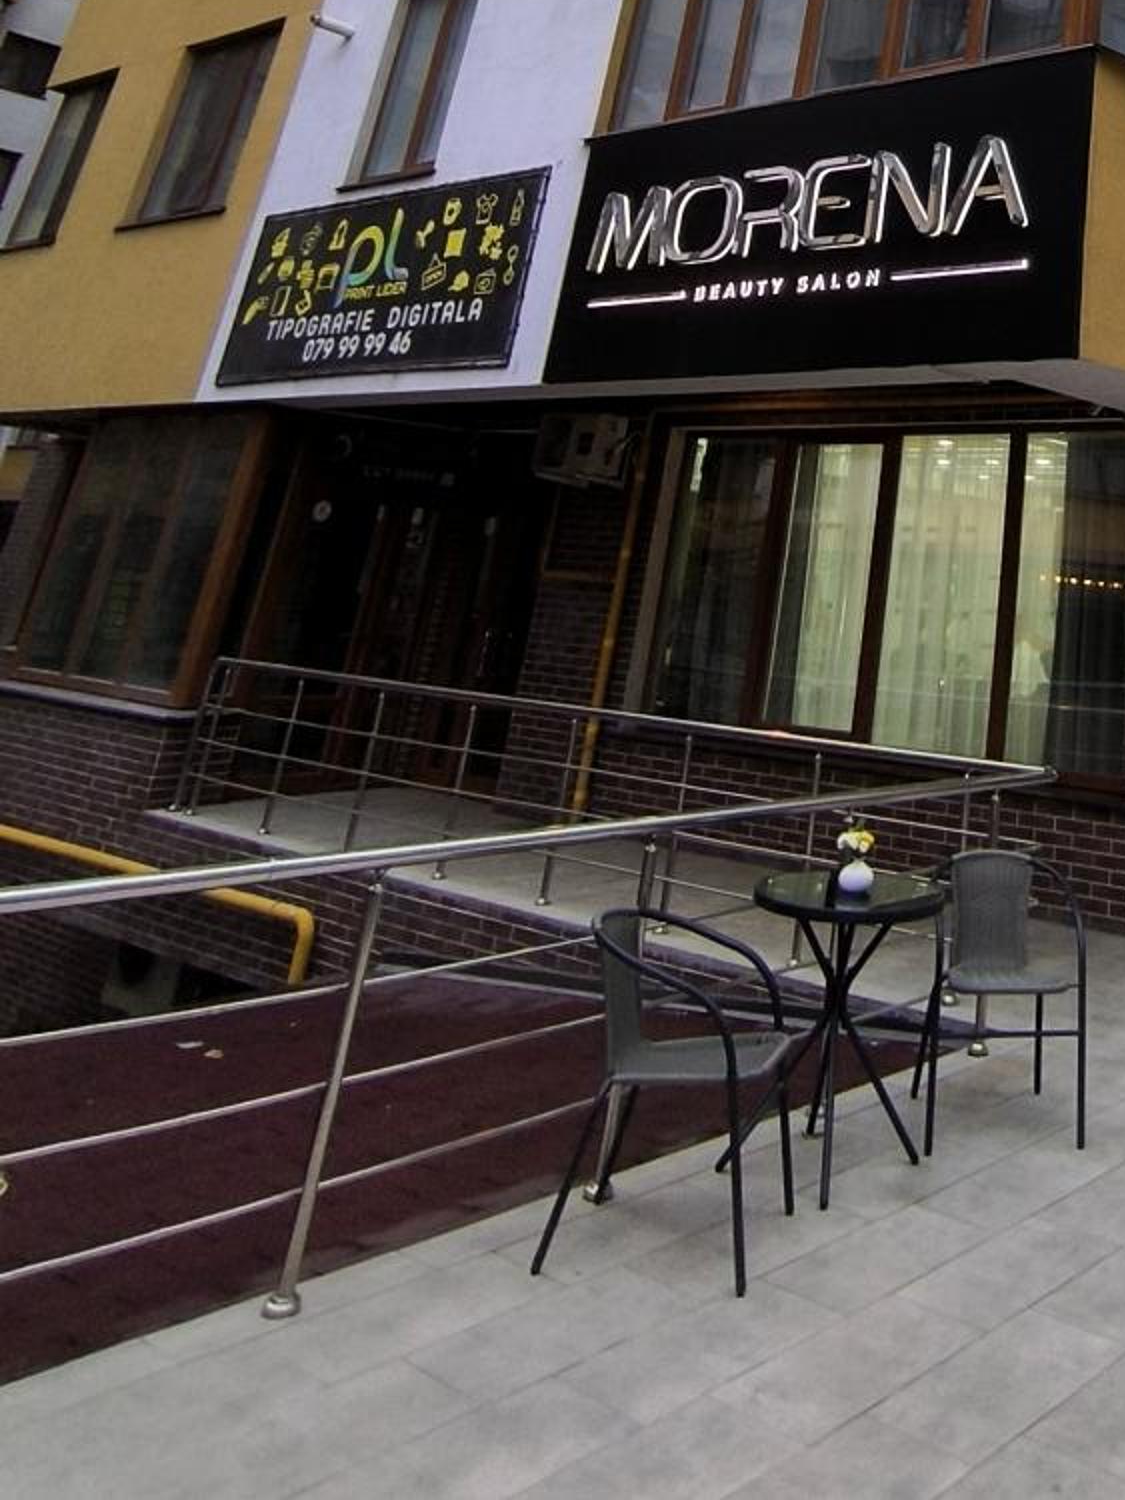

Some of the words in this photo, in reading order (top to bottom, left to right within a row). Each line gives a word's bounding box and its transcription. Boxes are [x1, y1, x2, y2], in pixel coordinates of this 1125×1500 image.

[586, 134, 1028, 273] MORENA
[693, 276, 786, 302] BEAUTY
[797, 268, 881, 294] SALON
[266, 308, 375, 341] TIPOGRAFIE
[386, 298, 483, 329] DIGITALA
[301, 337, 334, 363] 079
[337, 334, 360, 359] 99
[363, 331, 387, 356] 99
[388, 329, 412, 355] 46
